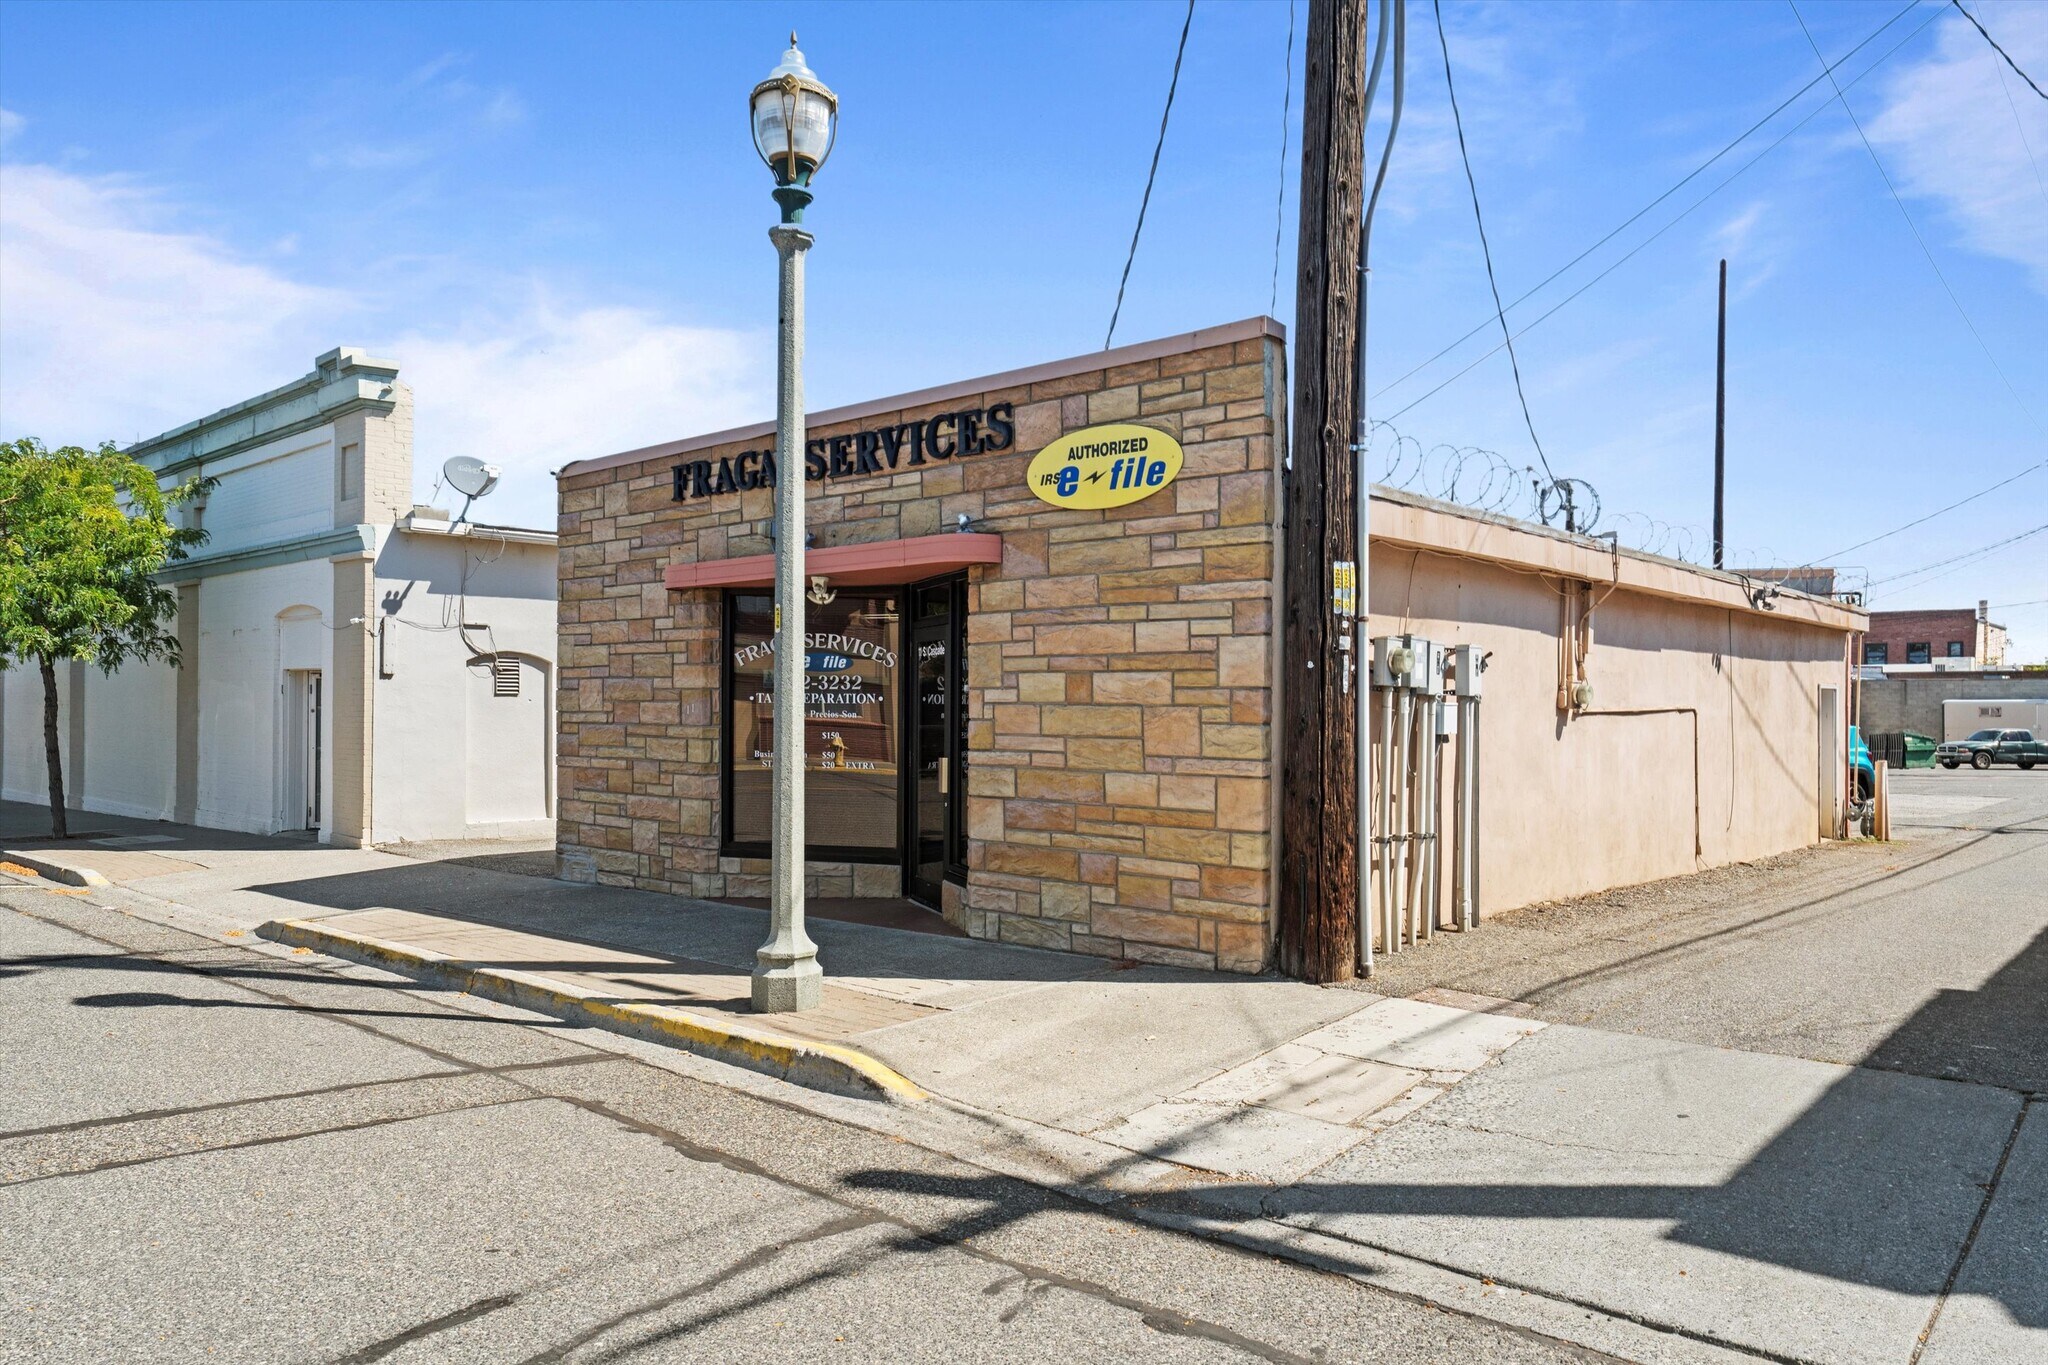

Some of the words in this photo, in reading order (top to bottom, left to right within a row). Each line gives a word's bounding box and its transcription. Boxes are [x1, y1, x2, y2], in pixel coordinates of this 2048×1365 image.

[671, 449, 777, 501] FRAGA
[804, 402, 1014, 481] SERVICES
[1067, 437, 1149, 461] AUTHORIZED
[1040, 472, 1061, 486] IRS
[1056, 465, 1080, 497] e
[1109, 455, 1167, 490] file
[734, 637, 776, 667] FRA
[804, 632, 898, 668] SERVICES
[823, 655, 847, 668] file
[804, 674, 863, 690] 2-3232
[804, 692, 876, 705] EPARATION
[810, 709, 839, 719] Precios
[842, 709, 857, 719] Son
[822, 731, 840, 740] $150
[822, 751, 836, 760] $50
[822, 761, 836, 770] $20
[845, 761, 875, 770] EXTRA
